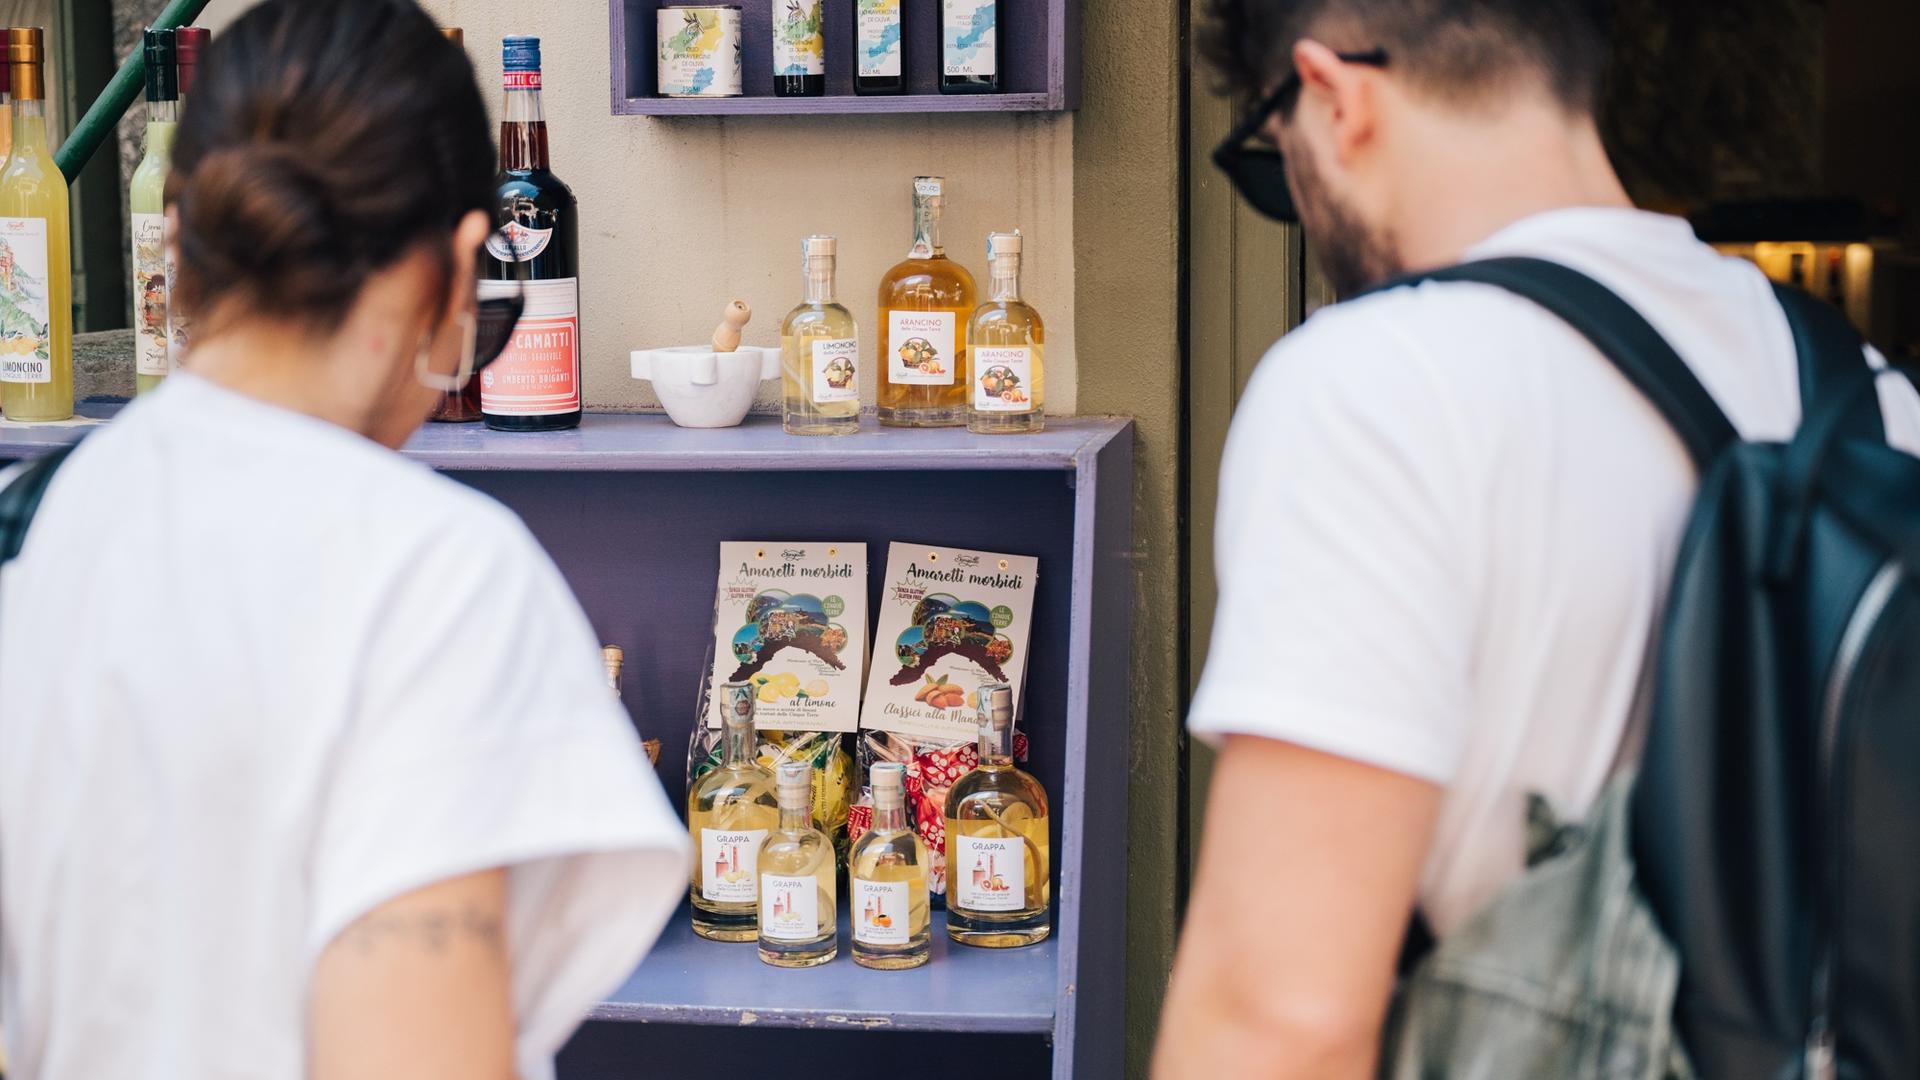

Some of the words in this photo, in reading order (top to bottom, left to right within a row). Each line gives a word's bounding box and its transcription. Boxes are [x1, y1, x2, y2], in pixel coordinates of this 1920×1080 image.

[516, 332, 569, 349] CAMATTI
[823, 341, 856, 350] LIMONCINO
[3, 362, 43, 373] LIMONCINO
[740, 562, 796, 578] Amaretti
[801, 564, 854, 579] morbidi
[907, 563, 965, 583] Amaretti
[969, 573, 1023, 589] morbidi
[897, 586, 909, 594] SENZA
[909, 588, 925, 596] GLUTINE
[790, 698, 799, 707] al
[804, 699, 837, 708] limone
[883, 703, 921, 719] Classici
[925, 709, 945, 720] alla
[717, 835, 750, 843] GRAPPA
[972, 842, 1005, 850] GRAPPA
[772, 880, 802, 888] GRAPPA
